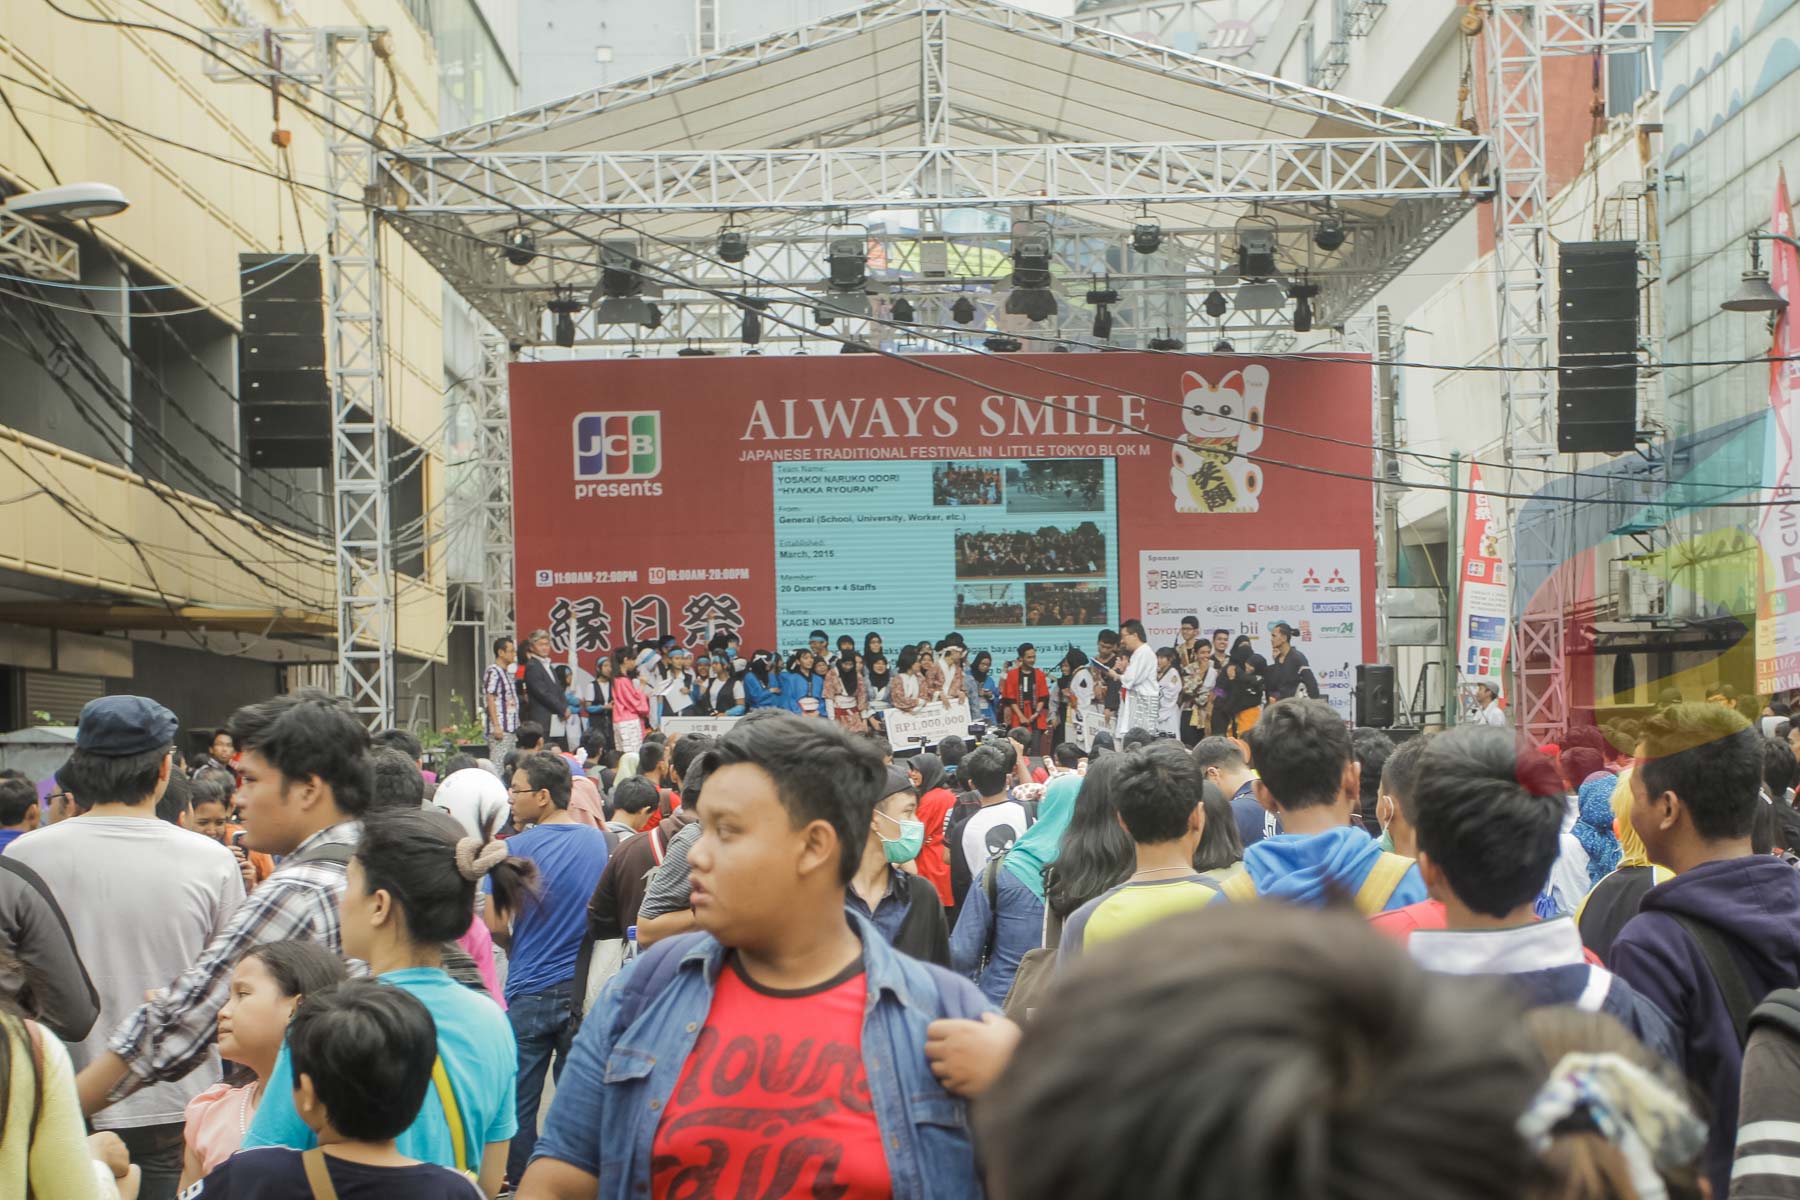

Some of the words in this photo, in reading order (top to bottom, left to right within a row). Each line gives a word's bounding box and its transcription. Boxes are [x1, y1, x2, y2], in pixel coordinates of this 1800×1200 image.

[739, 395, 958, 440] ALWAYS
[980, 394, 1151, 437] SMILE
[578, 434, 655, 456] JCB
[739, 448, 811, 462] JAPANESE
[815, 447, 907, 460] TRADITIONAL
[910, 446, 975, 458] FESTIVAL
[979, 446, 992, 457] IN
[999, 445, 1045, 457] LITTLE
[1045, 444, 1096, 456] TOKYO
[1099, 444, 1136, 456] BLOK
[1139, 444, 1150, 455] M
[778, 476, 821, 484] YOSAKOI
[824, 475, 865, 483] NARUKO
[868, 474, 899, 482] ODORI
[575, 480, 663, 500] presents
[779, 515, 814, 524] General
[813, 550, 834, 558] 2015
[650, 569, 664, 579] 10
[1160, 570, 1203, 580] RAMEN
[781, 585, 791, 593] 20
[794, 584, 831, 592] Dancers
[850, 583, 877, 591] Staffs
[1160, 579, 1177, 589] 38
[782, 618, 809, 627] KAGE
[812, 618, 826, 626] NO
[829, 617, 895, 626] MATSURIBITO
[1240, 621, 1258, 634] bii
